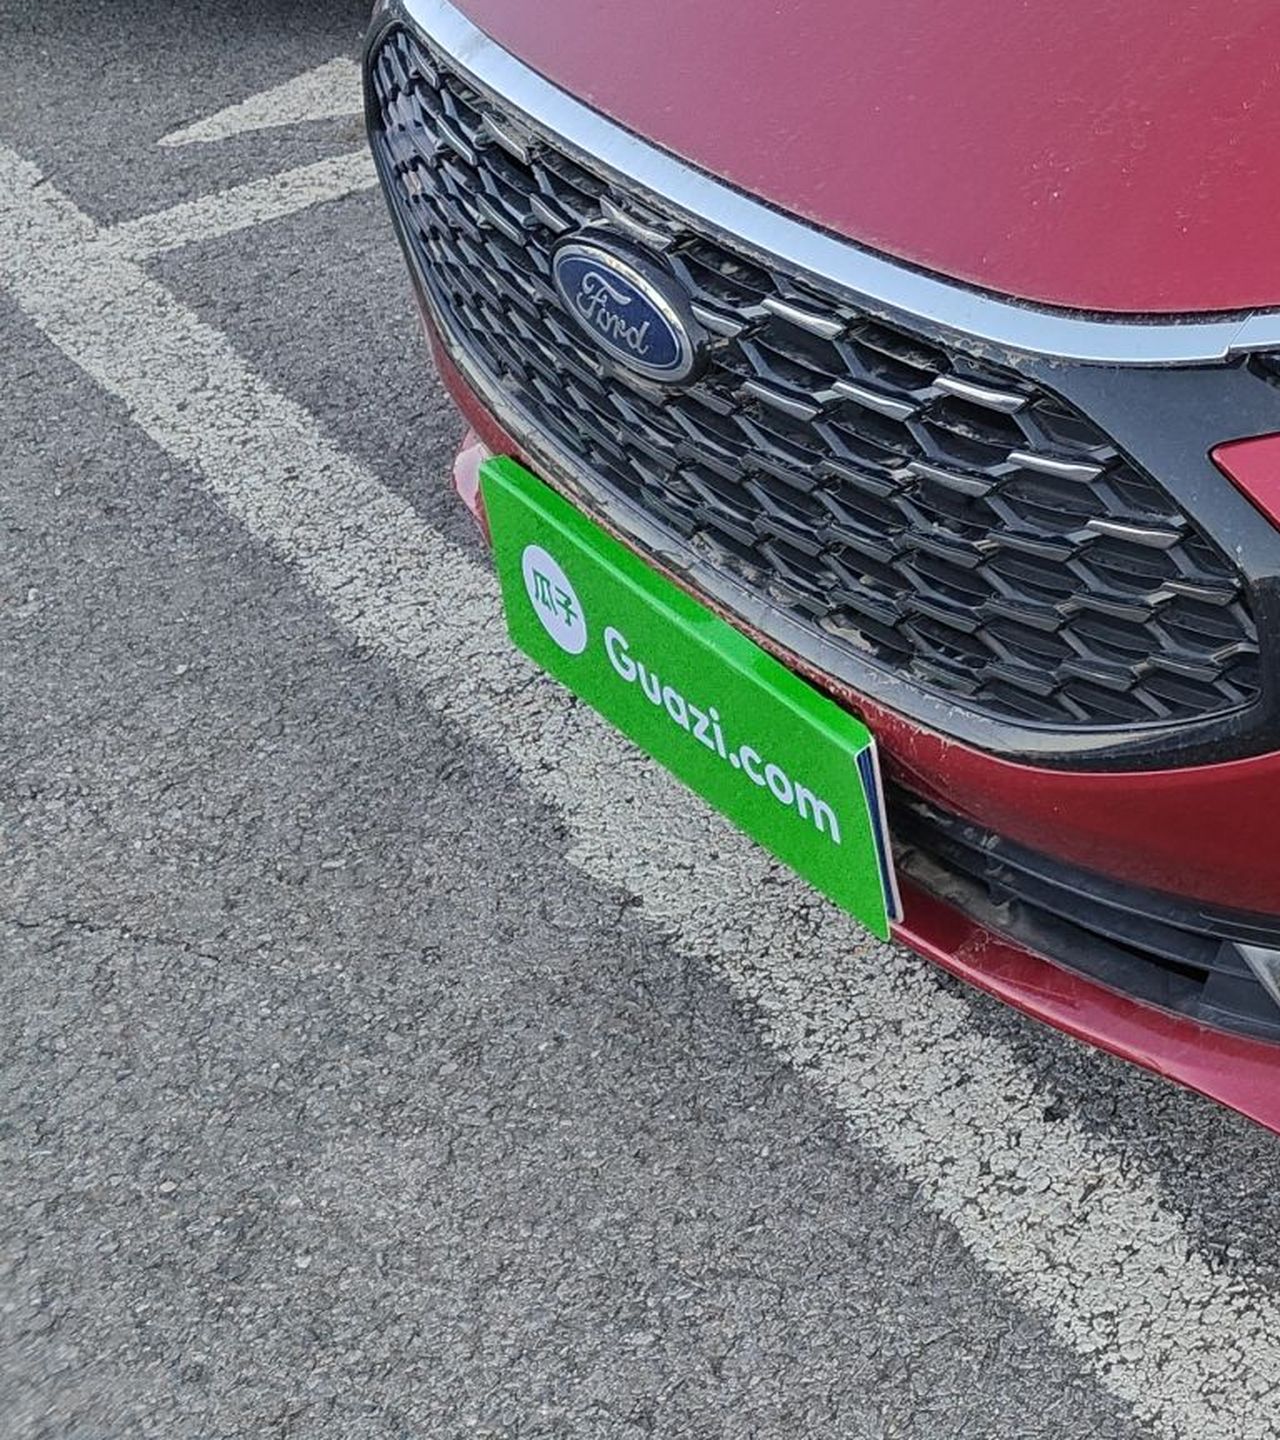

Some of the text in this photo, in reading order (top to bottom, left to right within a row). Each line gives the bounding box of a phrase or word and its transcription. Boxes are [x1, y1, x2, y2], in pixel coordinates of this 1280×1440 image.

[576, 271, 651, 348] Ford
[532, 566, 842, 846] 瓜子 Guazi.com
